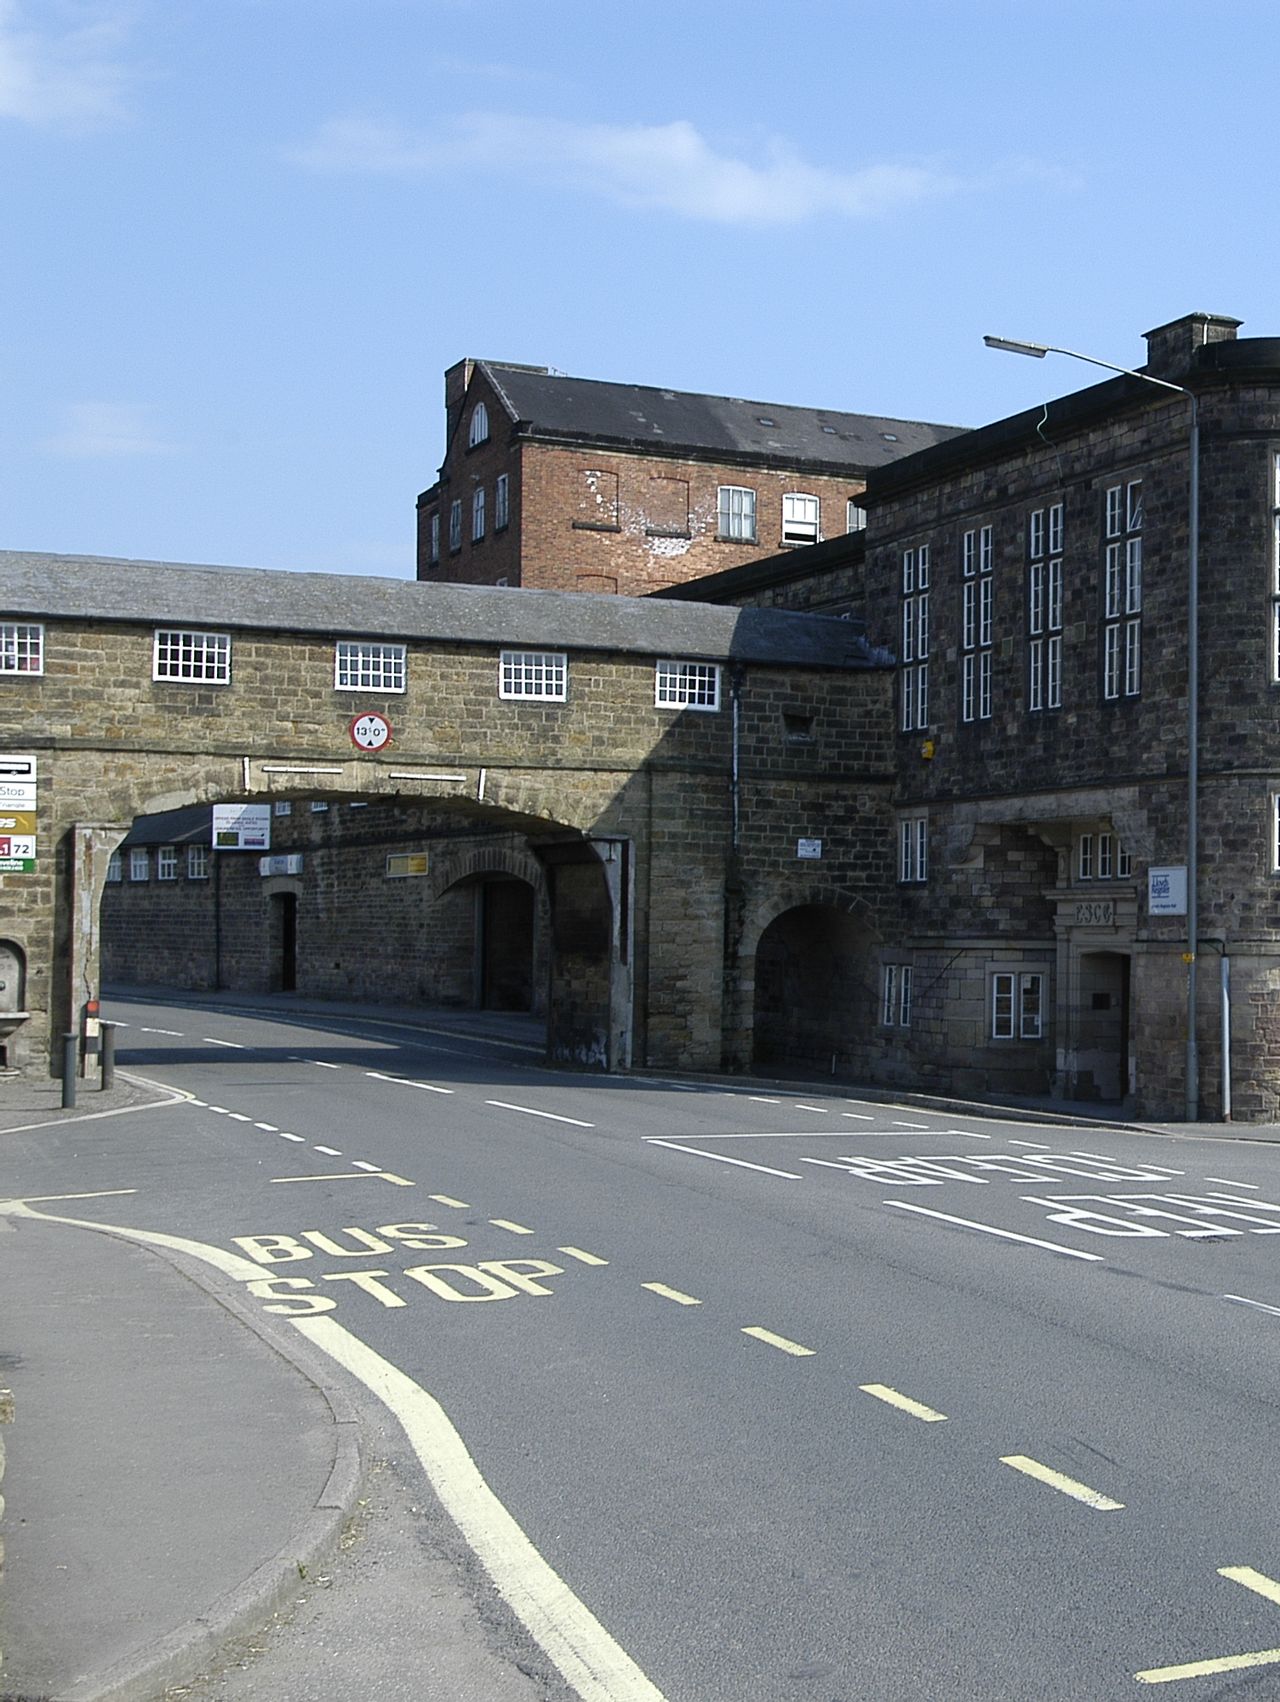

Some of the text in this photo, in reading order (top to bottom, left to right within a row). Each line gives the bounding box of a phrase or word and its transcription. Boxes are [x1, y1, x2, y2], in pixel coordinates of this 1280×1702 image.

[14, 844, 30, 854] 72
[800, 1154, 1172, 1186] CLEAR
[230, 1222, 468, 1264] BUS
[246, 1259, 565, 1315] STOP
